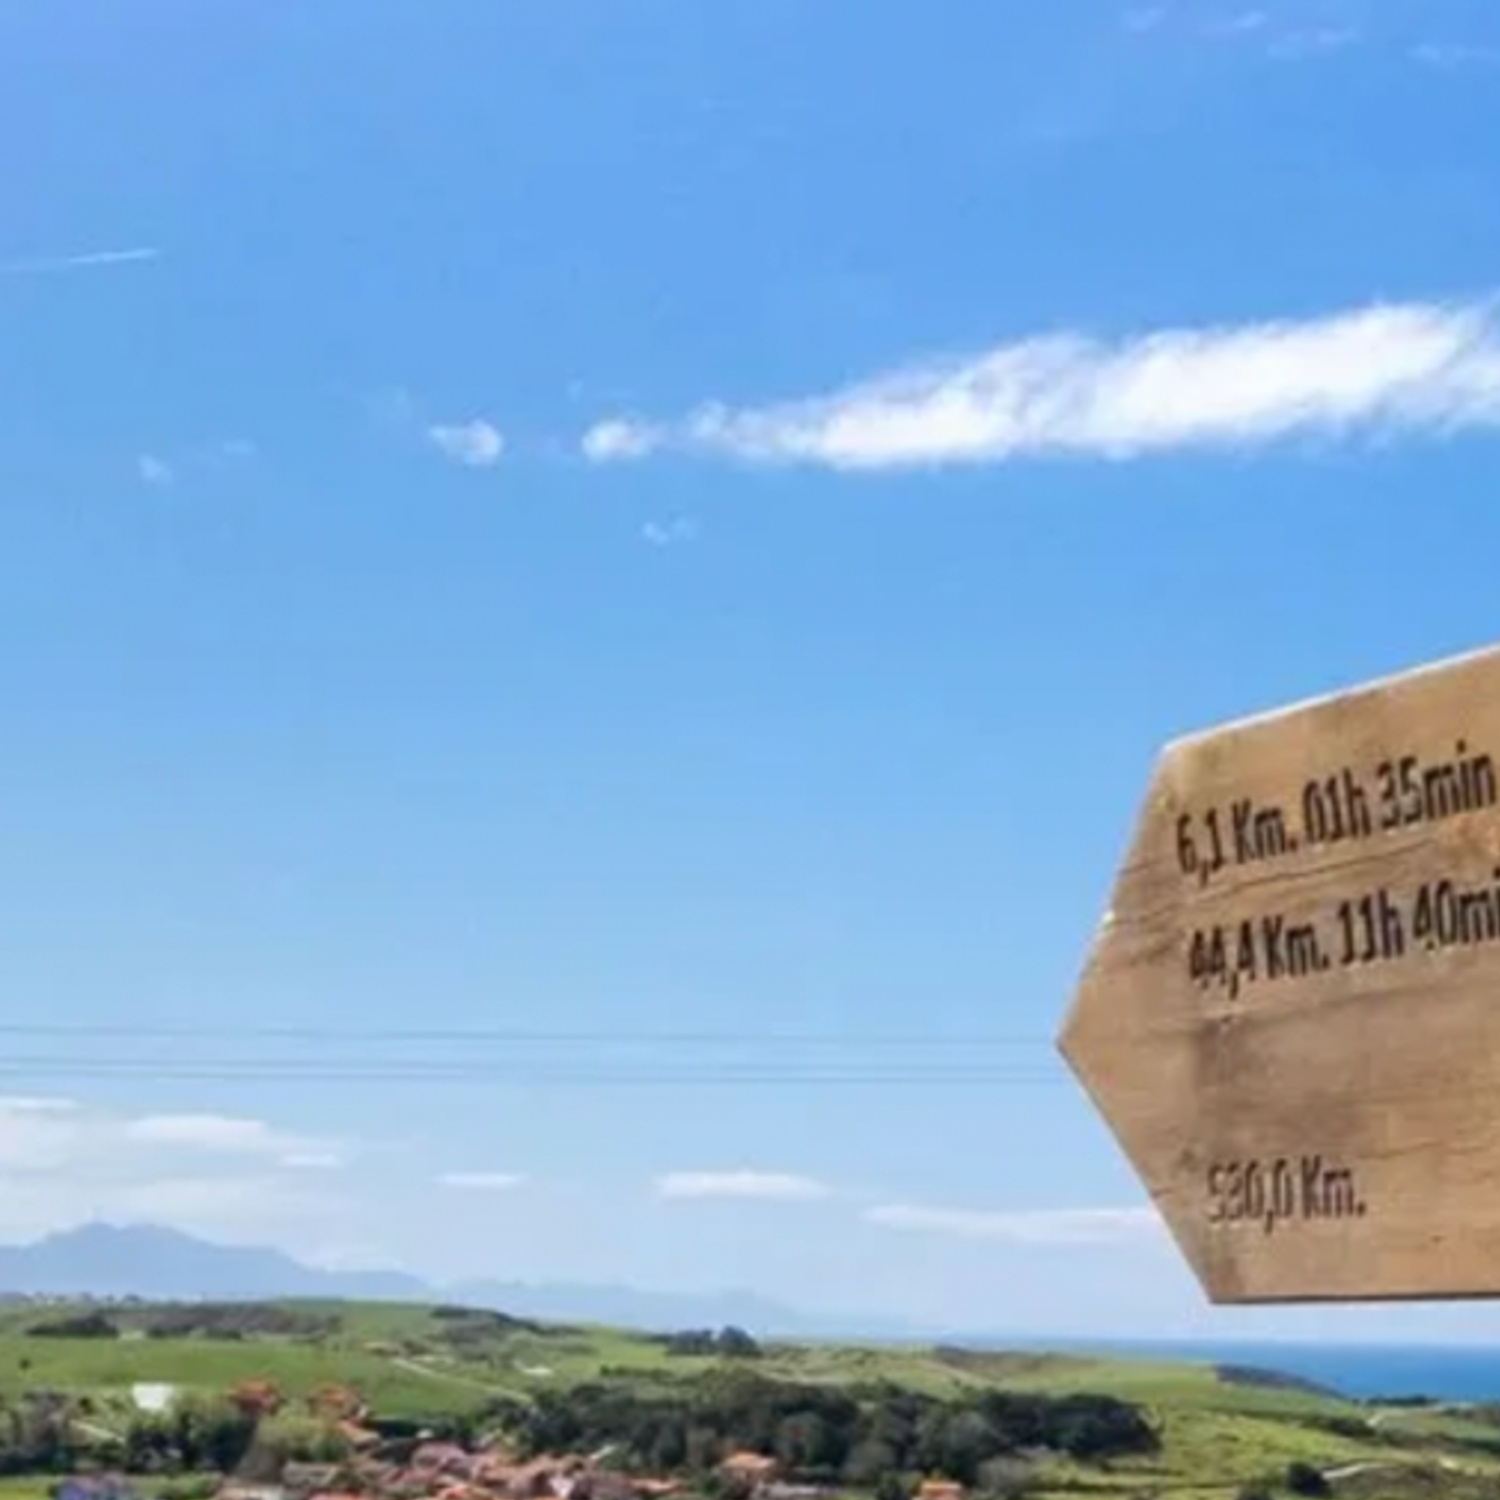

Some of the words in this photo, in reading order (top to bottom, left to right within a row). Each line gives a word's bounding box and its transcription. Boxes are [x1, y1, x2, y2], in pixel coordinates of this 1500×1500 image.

[1177, 808, 1224, 888] 6,1
[1232, 799, 1298, 864] Km.
[1302, 767, 1371, 845] 01h
[1377, 739, 1498, 829] 35min
[1188, 919, 1256, 1000] 44,4
[1262, 915, 1330, 979] Km.
[1338, 887, 1406, 965] 11h
[1301, 1154, 1367, 1219] Km.
